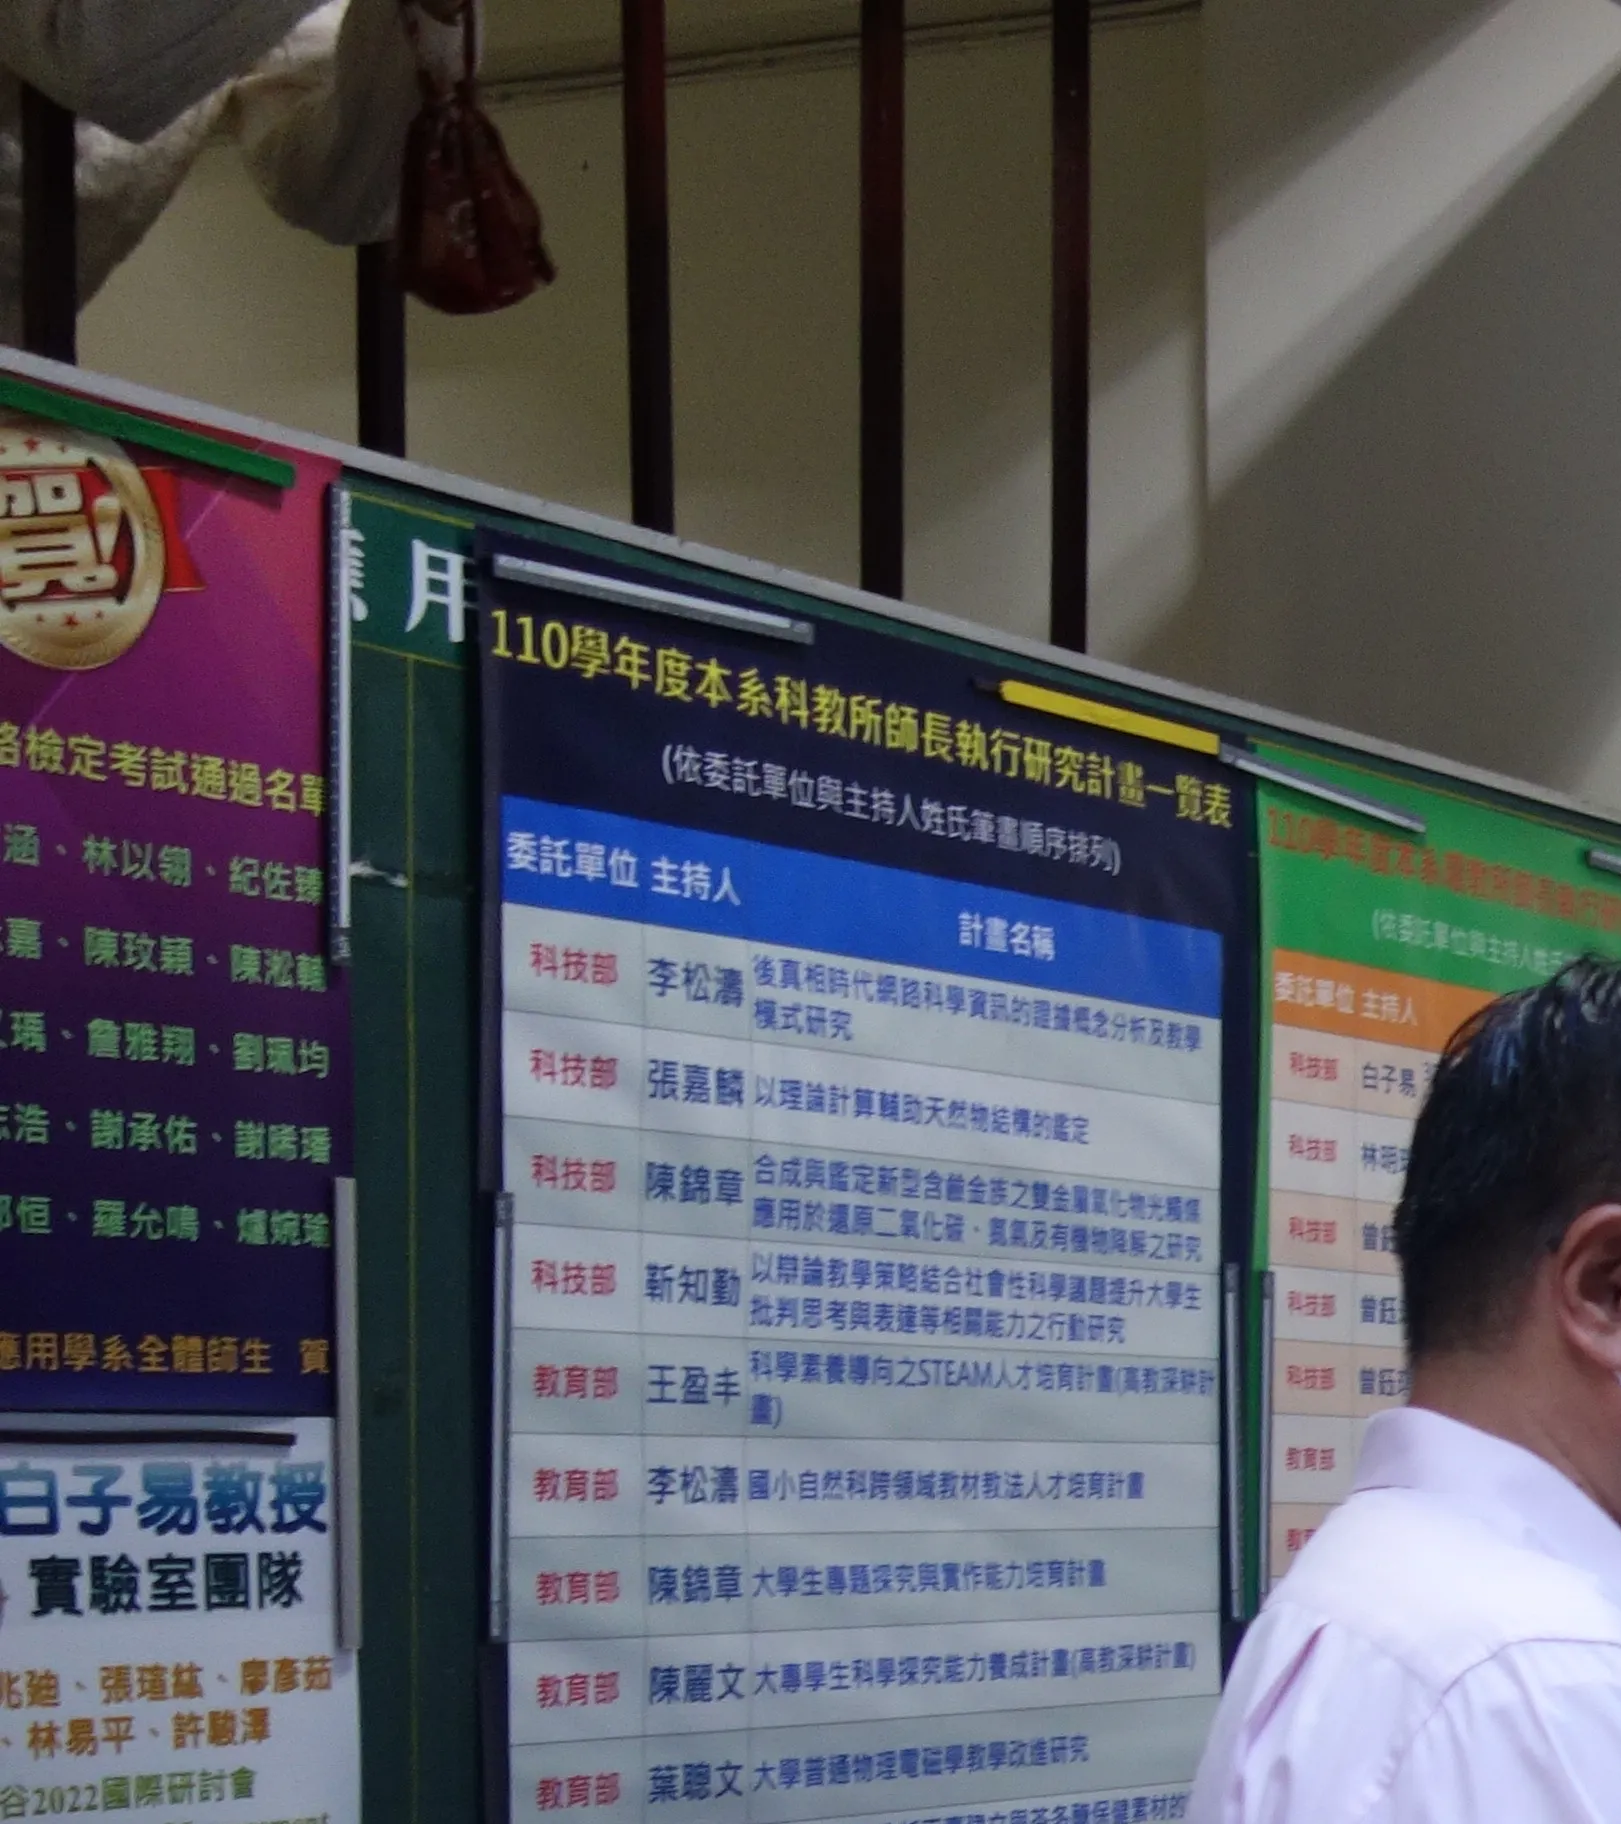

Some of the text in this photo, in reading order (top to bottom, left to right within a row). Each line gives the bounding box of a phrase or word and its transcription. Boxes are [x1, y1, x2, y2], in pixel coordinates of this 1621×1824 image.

[506, 830, 1057, 963] 委託單位 主持人 計畫名稱
[530, 943, 618, 986] 科技部
[754, 998, 853, 1041] 模式研究
[1361, 991, 1418, 1026] 主持人
[530, 1049, 618, 1090] 科技部
[1362, 1062, 1416, 1098] 白子易
[531, 1154, 617, 1193] 科技部
[531, 1260, 617, 1297] 科技部
[533, 1364, 618, 1400] 教育部
[0, 1460, 328, 1537] 白子易教授
[534, 1467, 619, 1502] 教育部
[29, 1552, 304, 1618] 實驗室團隊
[536, 1570, 620, 1606] 教育部
[537, 1671, 620, 1708] 教育部
[536, 1771, 620, 1810] 教育部
